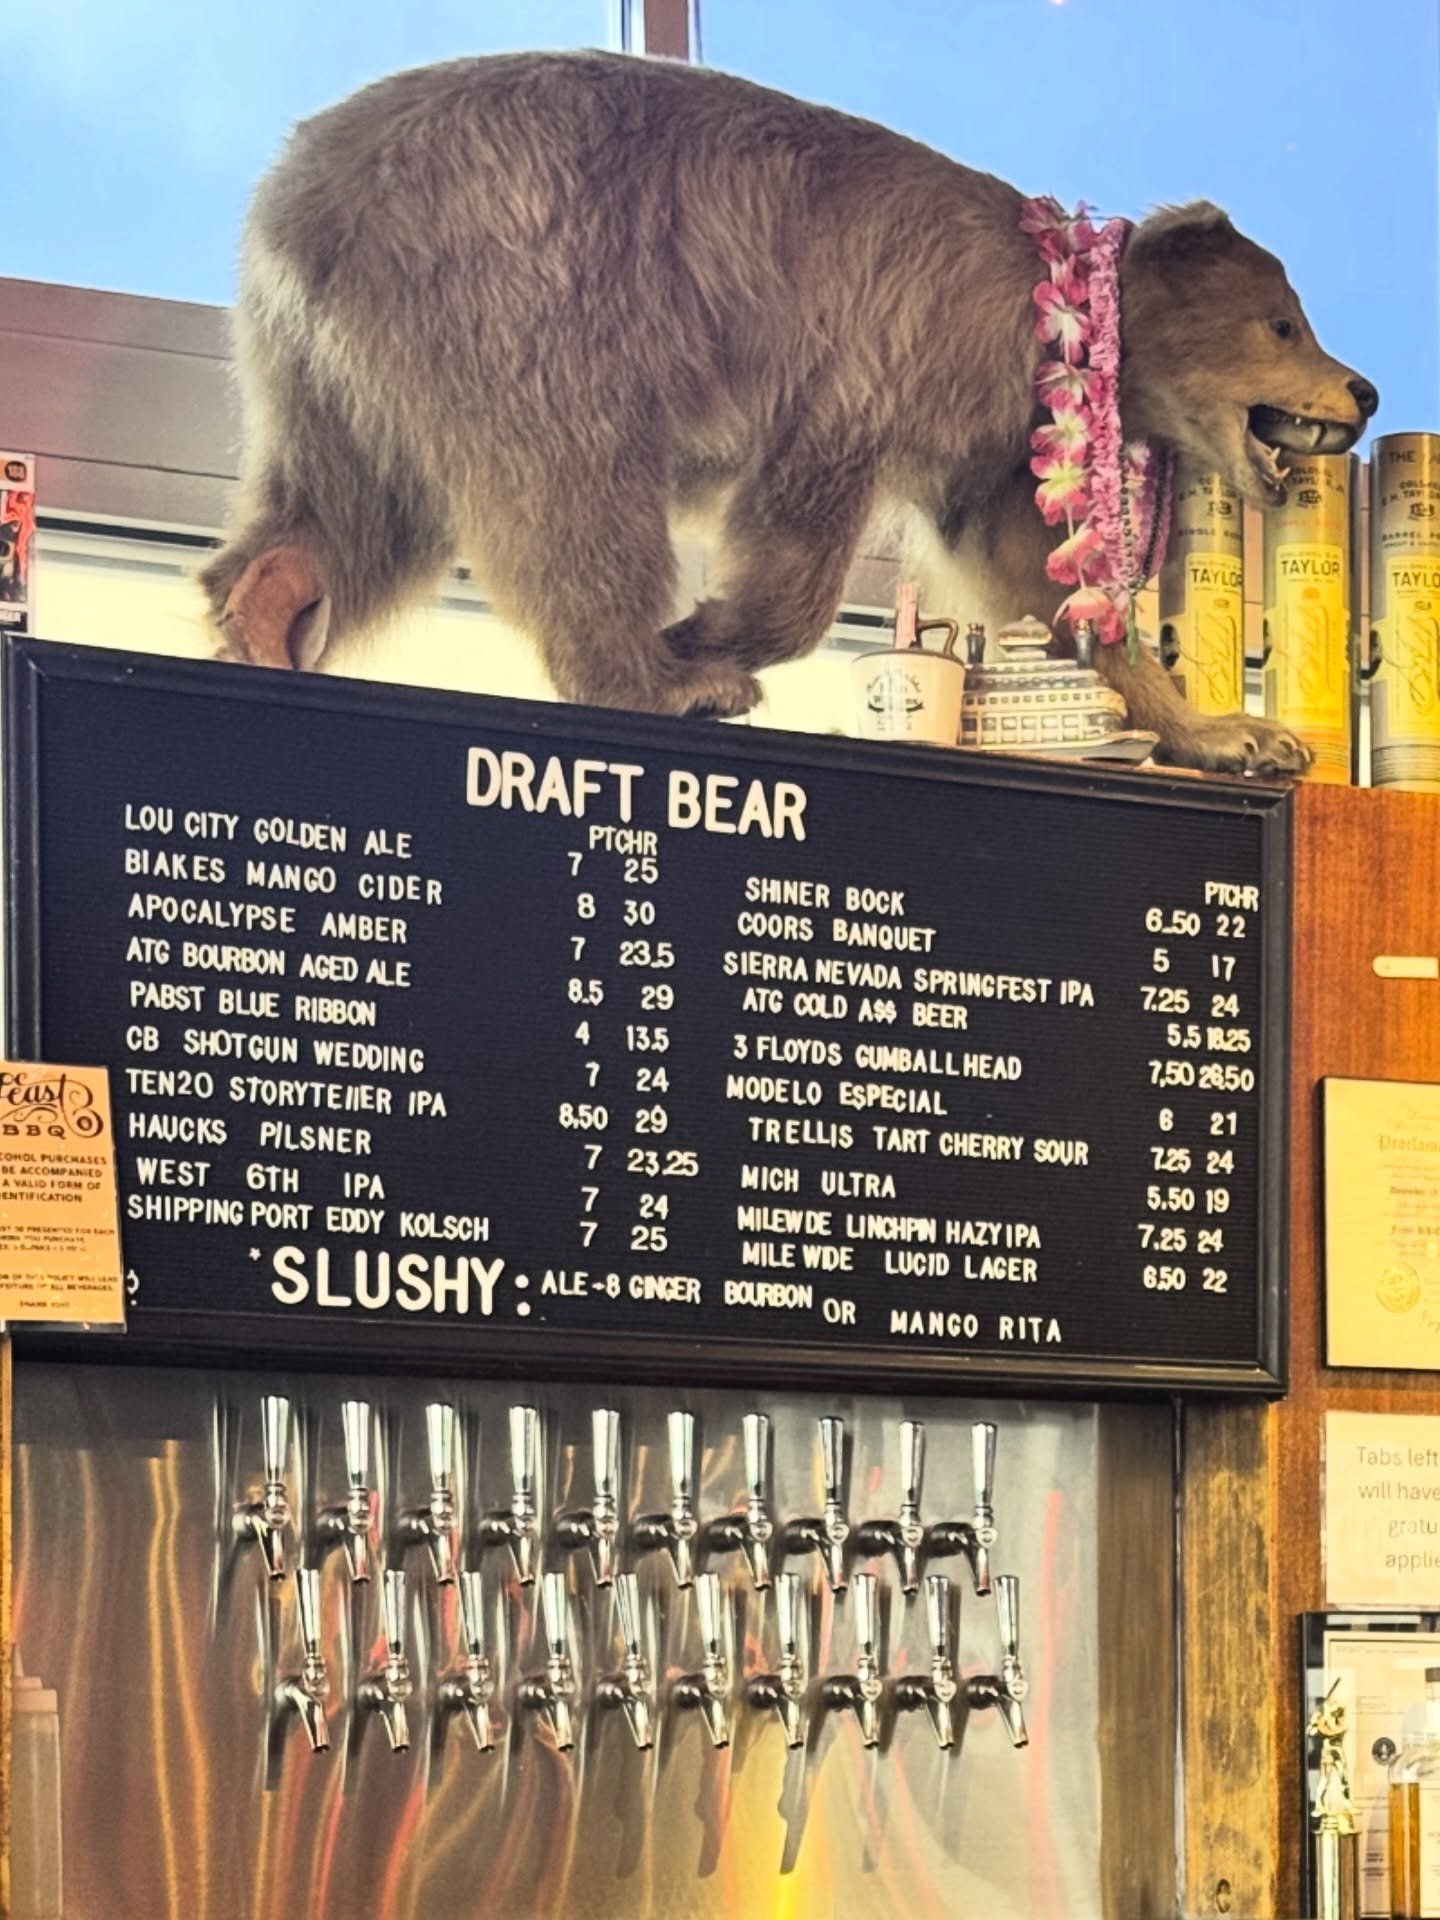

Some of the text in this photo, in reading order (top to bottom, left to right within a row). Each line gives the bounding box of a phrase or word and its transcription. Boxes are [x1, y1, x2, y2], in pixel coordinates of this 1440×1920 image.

[1280, 560, 1341, 576] TAYLOR
[466, 746, 807, 841] DRAFT BEAR
[125, 803, 659, 884] LOU CITY GOLDEN ALE 7 25
[246, 860, 337, 893] MANGO
[358, 873, 442, 905] CIDER
[577, 892, 596, 919] 8
[623, 899, 656, 927] 30
[744, 876, 830, 909] SHINER
[845, 886, 905, 916] BOCK
[1216, 913, 1246, 938] 22
[128, 892, 675, 969] APOCALYPSE AMBER 7 23.5
[737, 911, 1236, 982] COORS BANQUET 5 17
[126, 936, 170, 965] ATG
[182, 941, 285, 976] BOURBON
[299, 953, 359, 982] AGED
[365, 958, 411, 987] ALE
[641, 984, 674, 1010] 29
[723, 951, 1240, 1018] SIERRA NEVADA SPRINGFEST IPA 7.25 24
[130, 980, 206, 1012] PABST
[218, 988, 280, 1018] BLUE
[295, 995, 376, 1027] RIBBON
[575, 1021, 590, 1045] 4
[742, 987, 784, 1014] ATG
[793, 992, 848, 1020] COLD
[912, 1001, 968, 1030] BEER
[126, 1025, 670, 1093] CB SHOTGUN WEDDING 7 24
[733, 1034, 748, 1060] 3
[756, 1035, 843, 1067] FLOYDS
[3, 1124, 66, 1140] BBQ
[408, 1090, 447, 1117] IPA
[635, 1104, 668, 1134] 29
[726, 1074, 1237, 1136] MODELO ESPECIAL 6 21
[40, 1153, 107, 1166] PURCHASES
[129, 1112, 227, 1145] HAUCKS
[260, 1121, 371, 1155] PILSNER
[584, 1144, 603, 1170] 7
[748, 1116, 854, 1149] TRELLIS
[872, 1125, 931, 1154] TART
[939, 1132, 1024, 1160] CHERRY
[1033, 1138, 1089, 1166] SOUR
[1206, 1149, 1235, 1175] 24
[0, 1191, 82, 1203] ENTIFICATION
[2, 1179, 10, 1188] A
[14, 1179, 47, 1189] VALID
[20, 1166, 103, 1178] ACCOMPANIED
[136, 1156, 669, 1220] WEST 6TH IPA 7 24
[741, 1164, 1230, 1214] MICH ULTRA 5.50 19
[127, 1194, 668, 1252] SHIPPING PORT EDDY KOLSCH 7 25
[1137, 1223, 1187, 1252] 7.25
[1197, 1228, 1224, 1254] 24
[885, 1249, 950, 1277] LUCID
[964, 1255, 1038, 1283] LAGER
[1202, 1267, 1228, 1293] 22
[628, 1274, 701, 1305] GINGER
[724, 1280, 813, 1309] BOURBON
[822, 1298, 856, 1325] OR
[890, 1309, 979, 1338] MANGO
[999, 1315, 1062, 1344] RITA
[1356, 1445, 1440, 1468] Tabs left
[1358, 1481, 1440, 1501] will have
[1388, 1518, 1438, 1539] gratu
